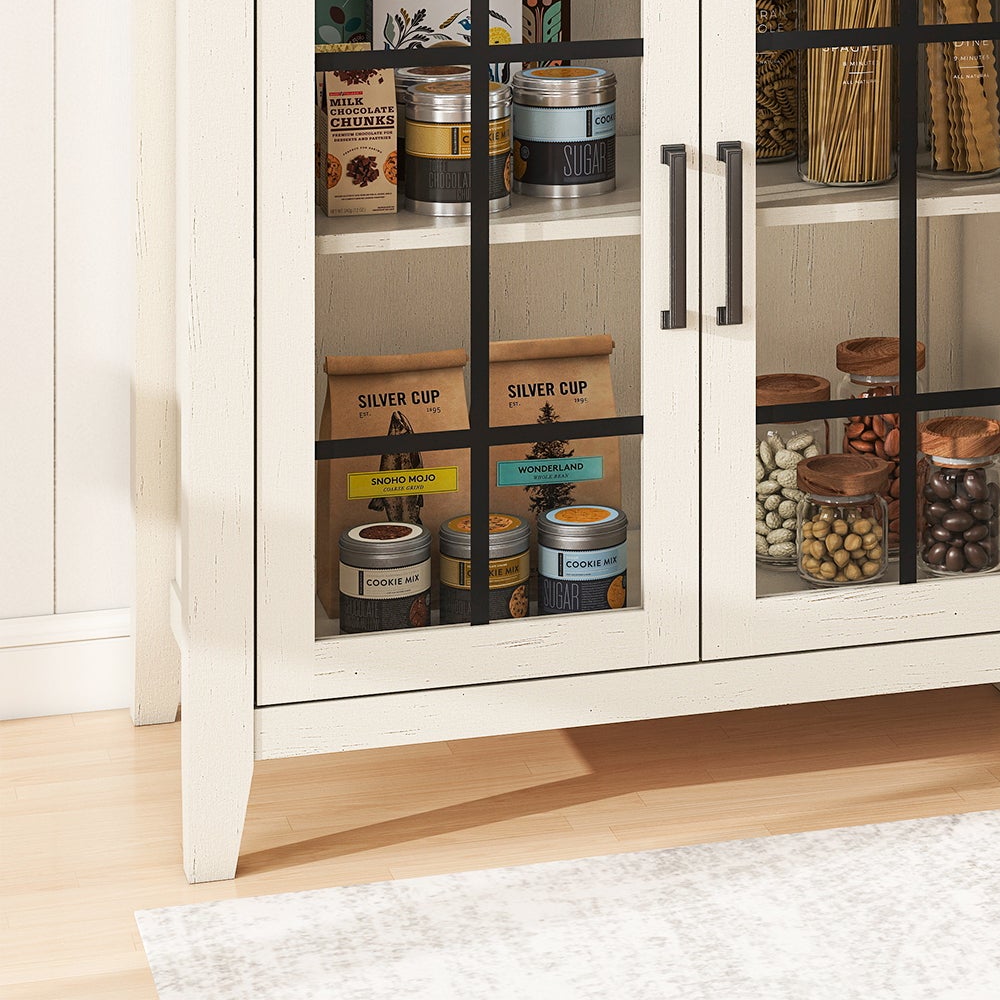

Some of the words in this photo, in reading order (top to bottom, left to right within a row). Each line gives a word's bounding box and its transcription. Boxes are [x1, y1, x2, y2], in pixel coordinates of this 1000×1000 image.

[329, 97, 364, 107] MILK
[329, 106, 395, 116] CHOCOLATE
[330, 115, 395, 128] CHUNKS
[563, 141, 608, 177] SUGAR
[507, 382, 555, 399] SILVER
[559, 380, 588, 396] CUP
[357, 392, 407, 409] SILVER
[411, 389, 440, 405] CUP
[518, 462, 584, 474] WONDERLAND
[371, 475, 406, 486] SNOHO
[408, 473, 436, 483] MOJO
[565, 559, 602, 569] COOKIE
[603, 556, 617, 566] MIX
[505, 565, 520, 575] MIX
[366, 577, 403, 587] COOKIE
[404, 574, 420, 584] MIX
[543, 579, 580, 610] SUGAR
